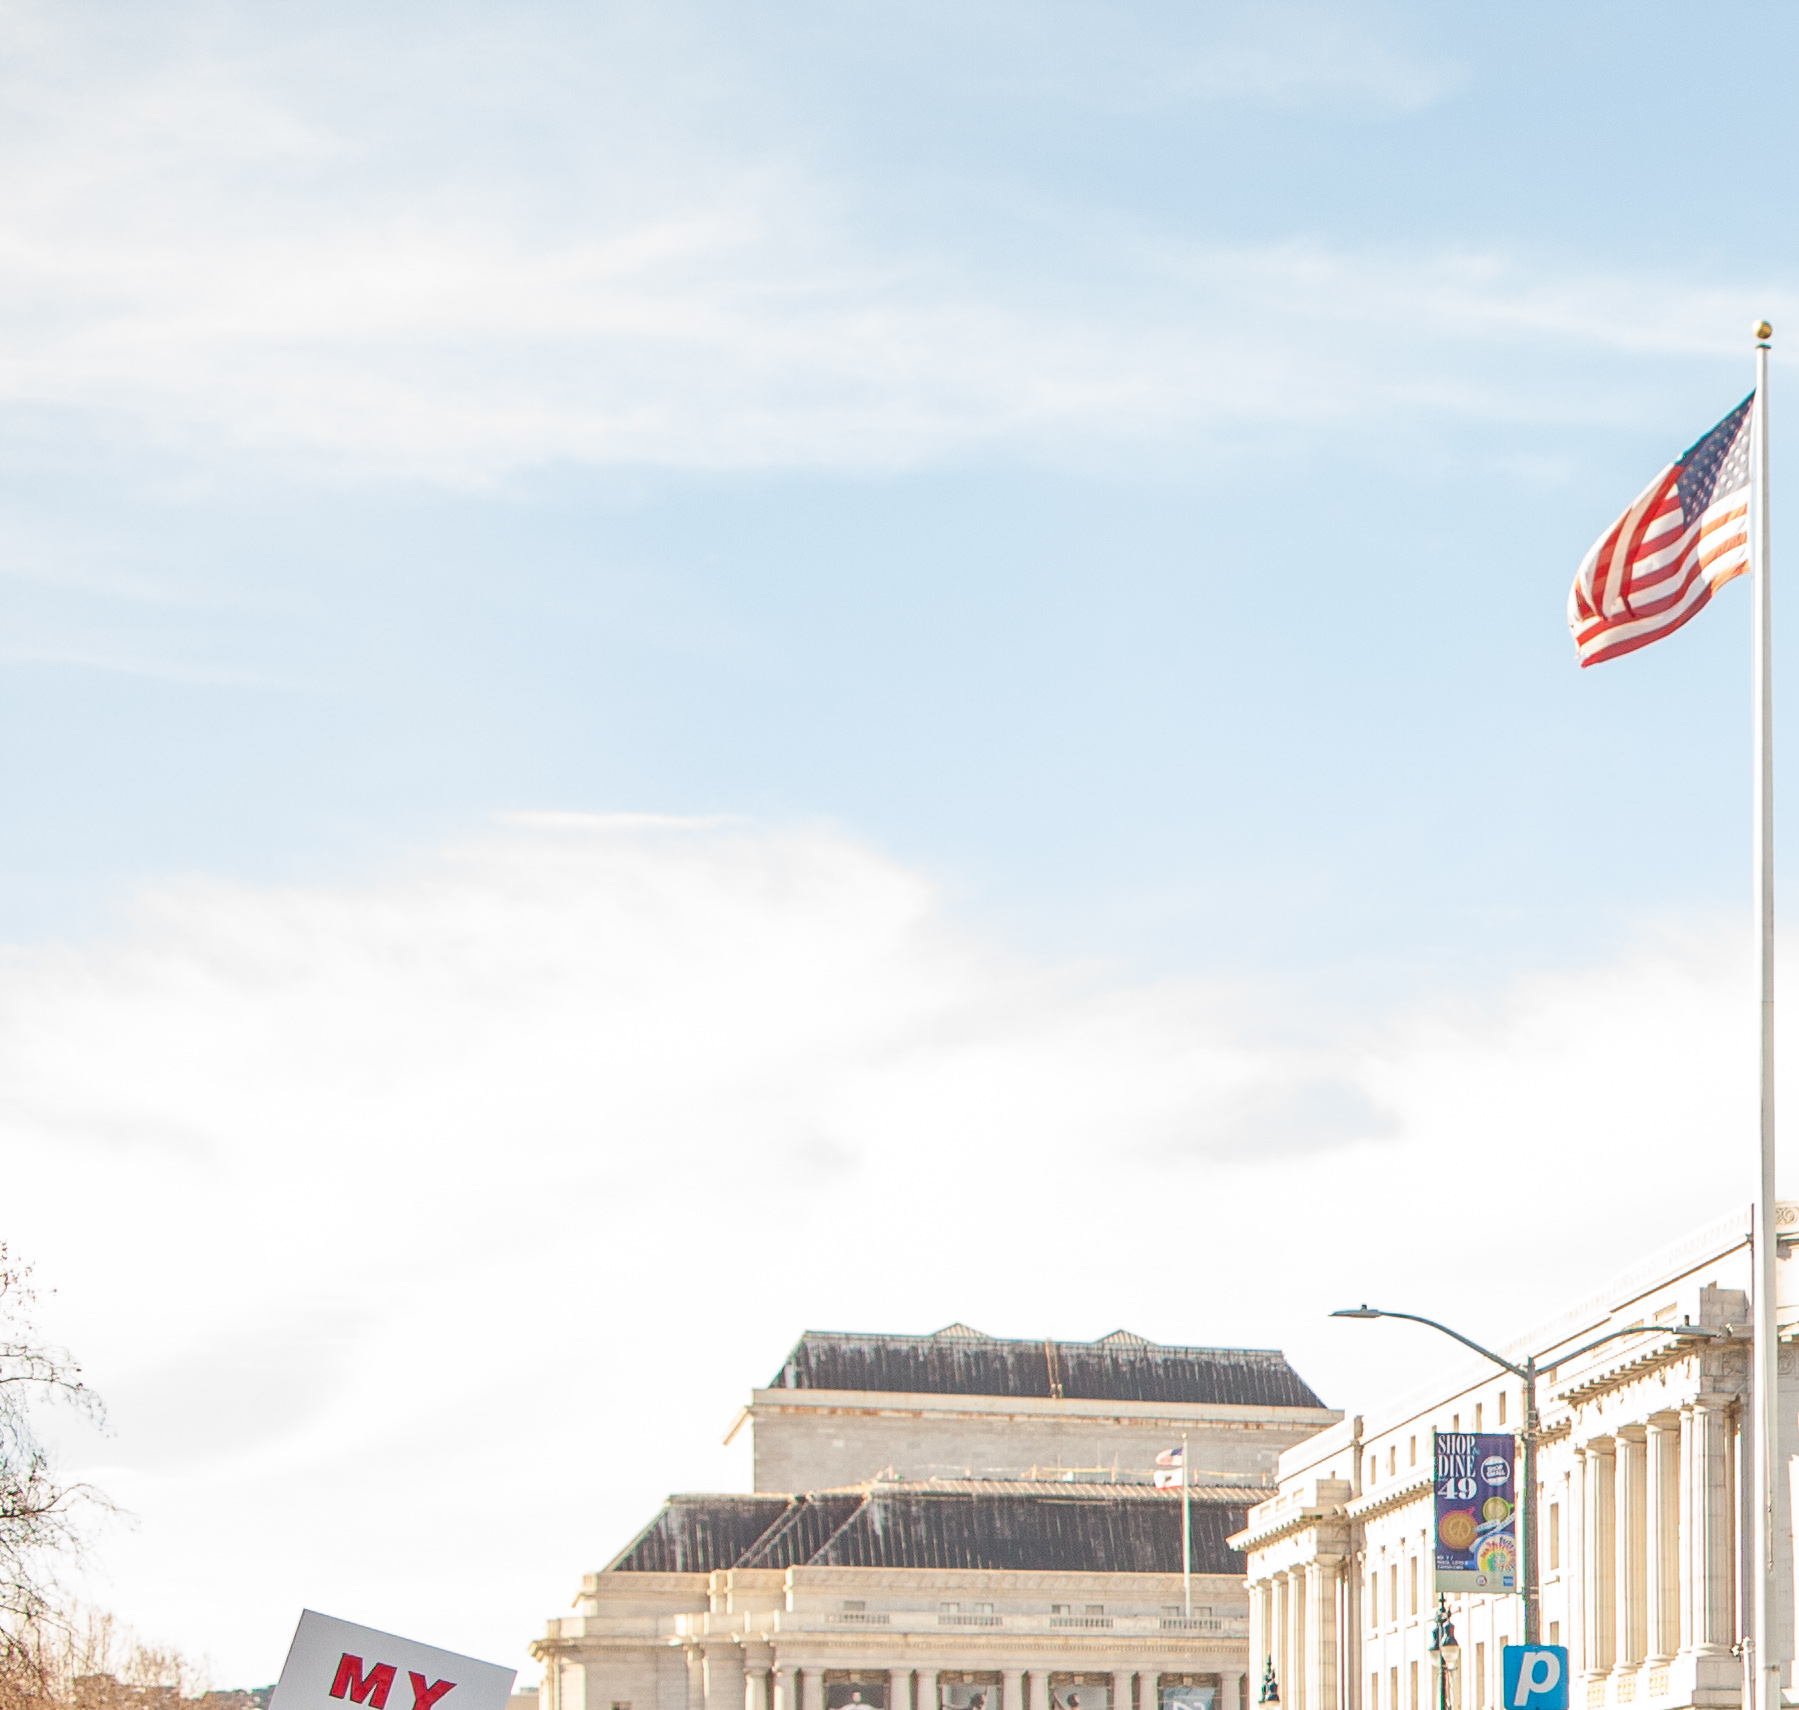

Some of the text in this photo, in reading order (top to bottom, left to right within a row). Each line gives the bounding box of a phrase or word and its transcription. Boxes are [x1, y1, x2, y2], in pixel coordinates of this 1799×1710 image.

[1438, 1435, 1475, 1455] SHOP
[1438, 1455, 1476, 1477] DINE
[1438, 1477, 1477, 1500] 49
